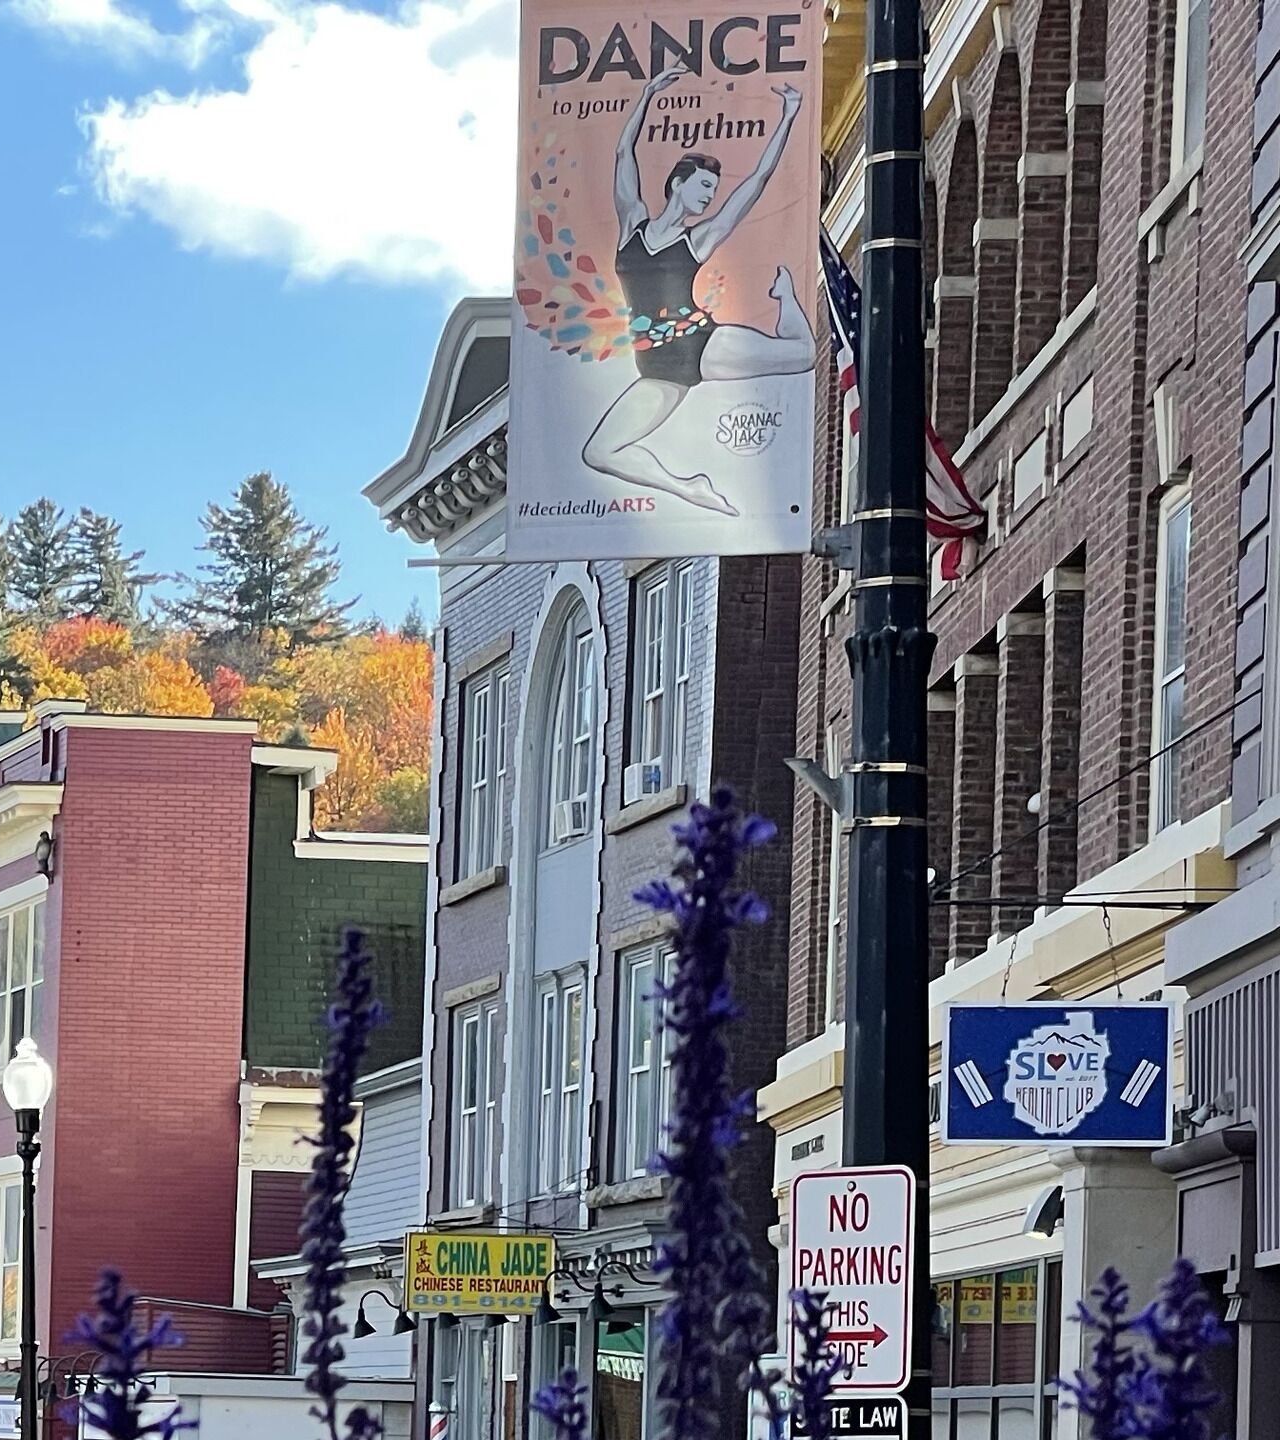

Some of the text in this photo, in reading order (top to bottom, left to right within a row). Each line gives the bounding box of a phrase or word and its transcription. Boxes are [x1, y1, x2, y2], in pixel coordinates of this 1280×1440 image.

[538, 13, 808, 87] DANCE
[551, 94, 702, 120] to your own
[647, 112, 766, 149] rhythm
[715, 411, 783, 445] SARANAC
[732, 427, 768, 449] LAKE
[518, 497, 657, 518] #decidedlyARTS
[1015, 1086, 1095, 1129] HEALTH CLUB
[829, 1192, 870, 1233] NO
[436, 1240, 547, 1277] CHINA JADE
[799, 1244, 903, 1287] PARKING
[413, 1277, 546, 1294] CHINESE RESTAURANT
[826, 1300, 869, 1327] THIS
[826, 1341, 869, 1368] SIDE
[859, 1406, 898, 1429] LAW
